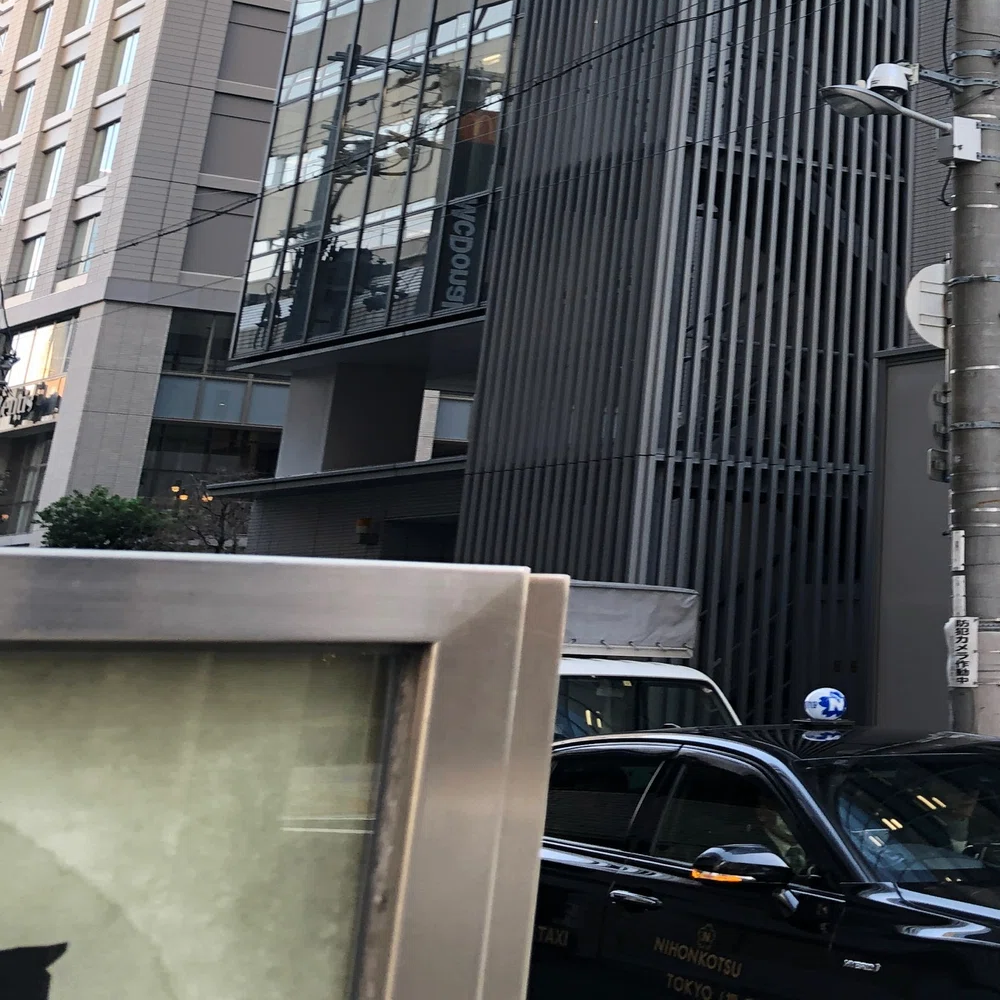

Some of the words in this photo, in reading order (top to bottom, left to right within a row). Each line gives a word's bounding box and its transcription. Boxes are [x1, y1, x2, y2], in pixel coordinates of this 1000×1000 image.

[955, 619, 970, 684] 防犯カメラ作動中
[538, 925, 568, 947] TAXI
[654, 937, 743, 979] NIHONKOTSU
[666, 973, 713, 1000] TOKYO
